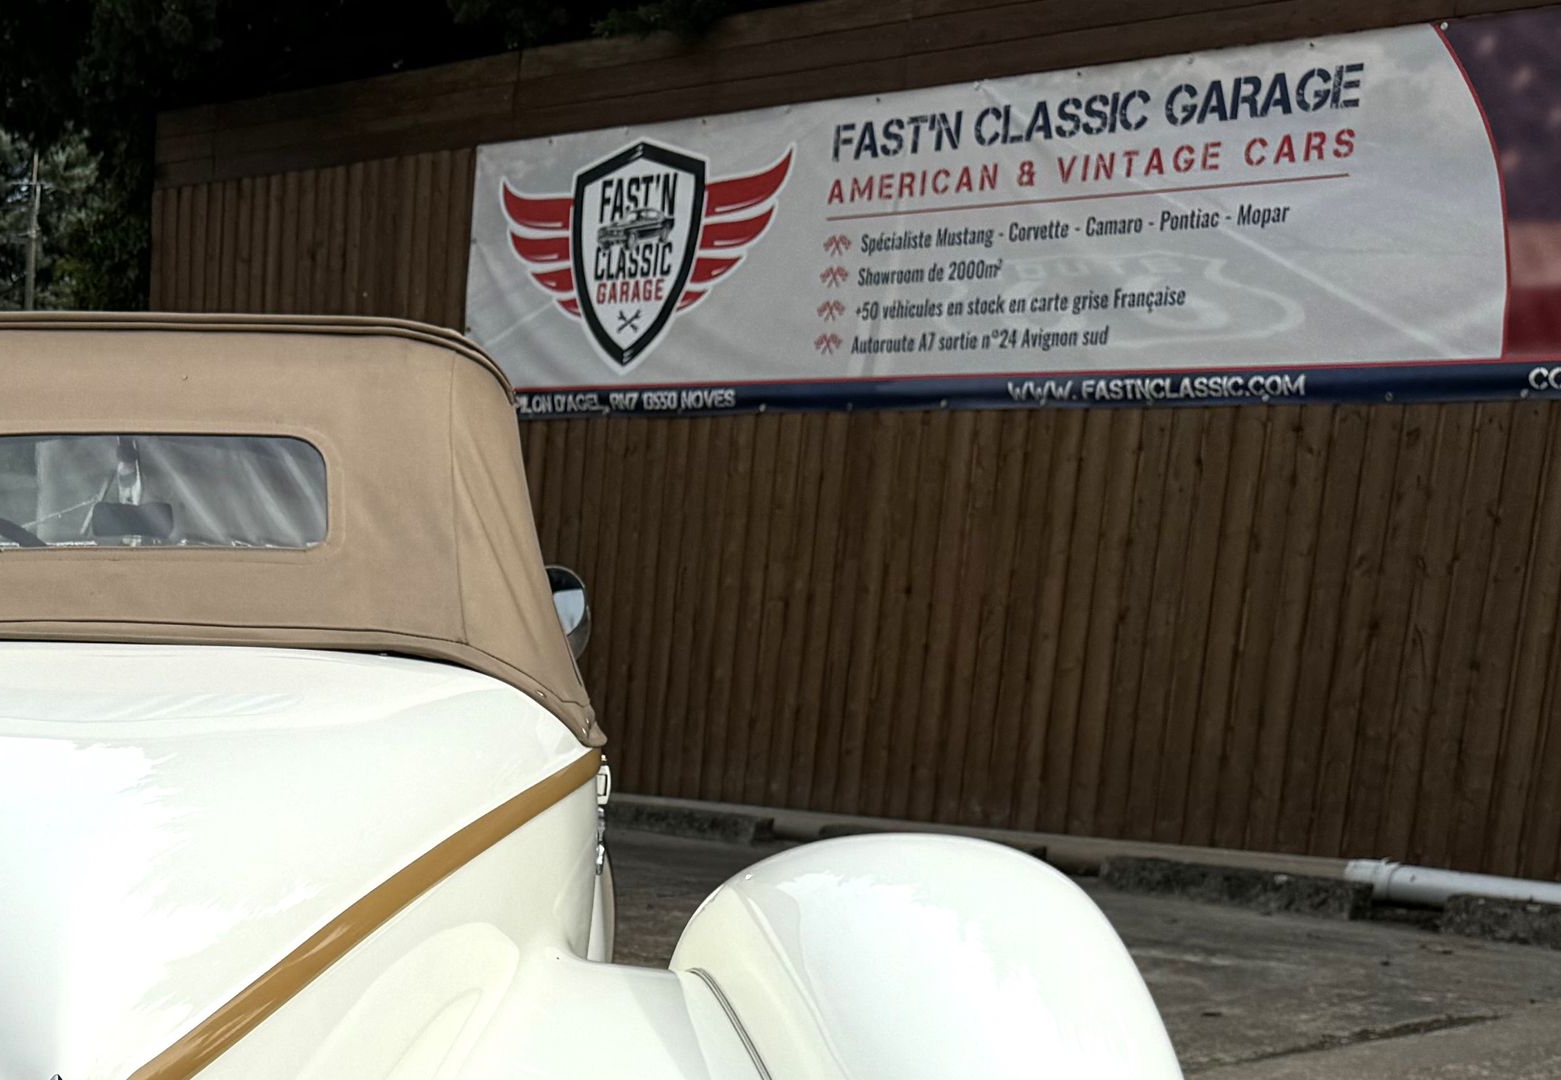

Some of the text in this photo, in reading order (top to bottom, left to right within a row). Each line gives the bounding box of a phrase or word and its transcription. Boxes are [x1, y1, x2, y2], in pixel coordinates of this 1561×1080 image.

[831, 63, 1364, 162] FAST'N CLASSIC GARAGE
[827, 128, 1356, 205] AMERICAN & VINTAGE CARS
[599, 172, 678, 224] FAST'N
[860, 231, 932, 256] Spécialiste
[935, 227, 994, 248] Mustang
[1008, 220, 1070, 243] Corvette
[1085, 216, 1143, 237] Camaro
[1159, 208, 1220, 231] Pontiac
[1236, 204, 1290, 229] Mopar
[594, 241, 673, 281] CLASSIC
[857, 267, 924, 287] Showroom
[927, 262, 944, 281] de
[596, 279, 664, 304] GARAGE
[855, 287, 1187, 321] +50 véhicules en stock en carte grise Française
[850, 325, 1110, 355] Autoroute A7 sortie n°24 Avignon sud
[680, 388, 736, 409] NOVES
